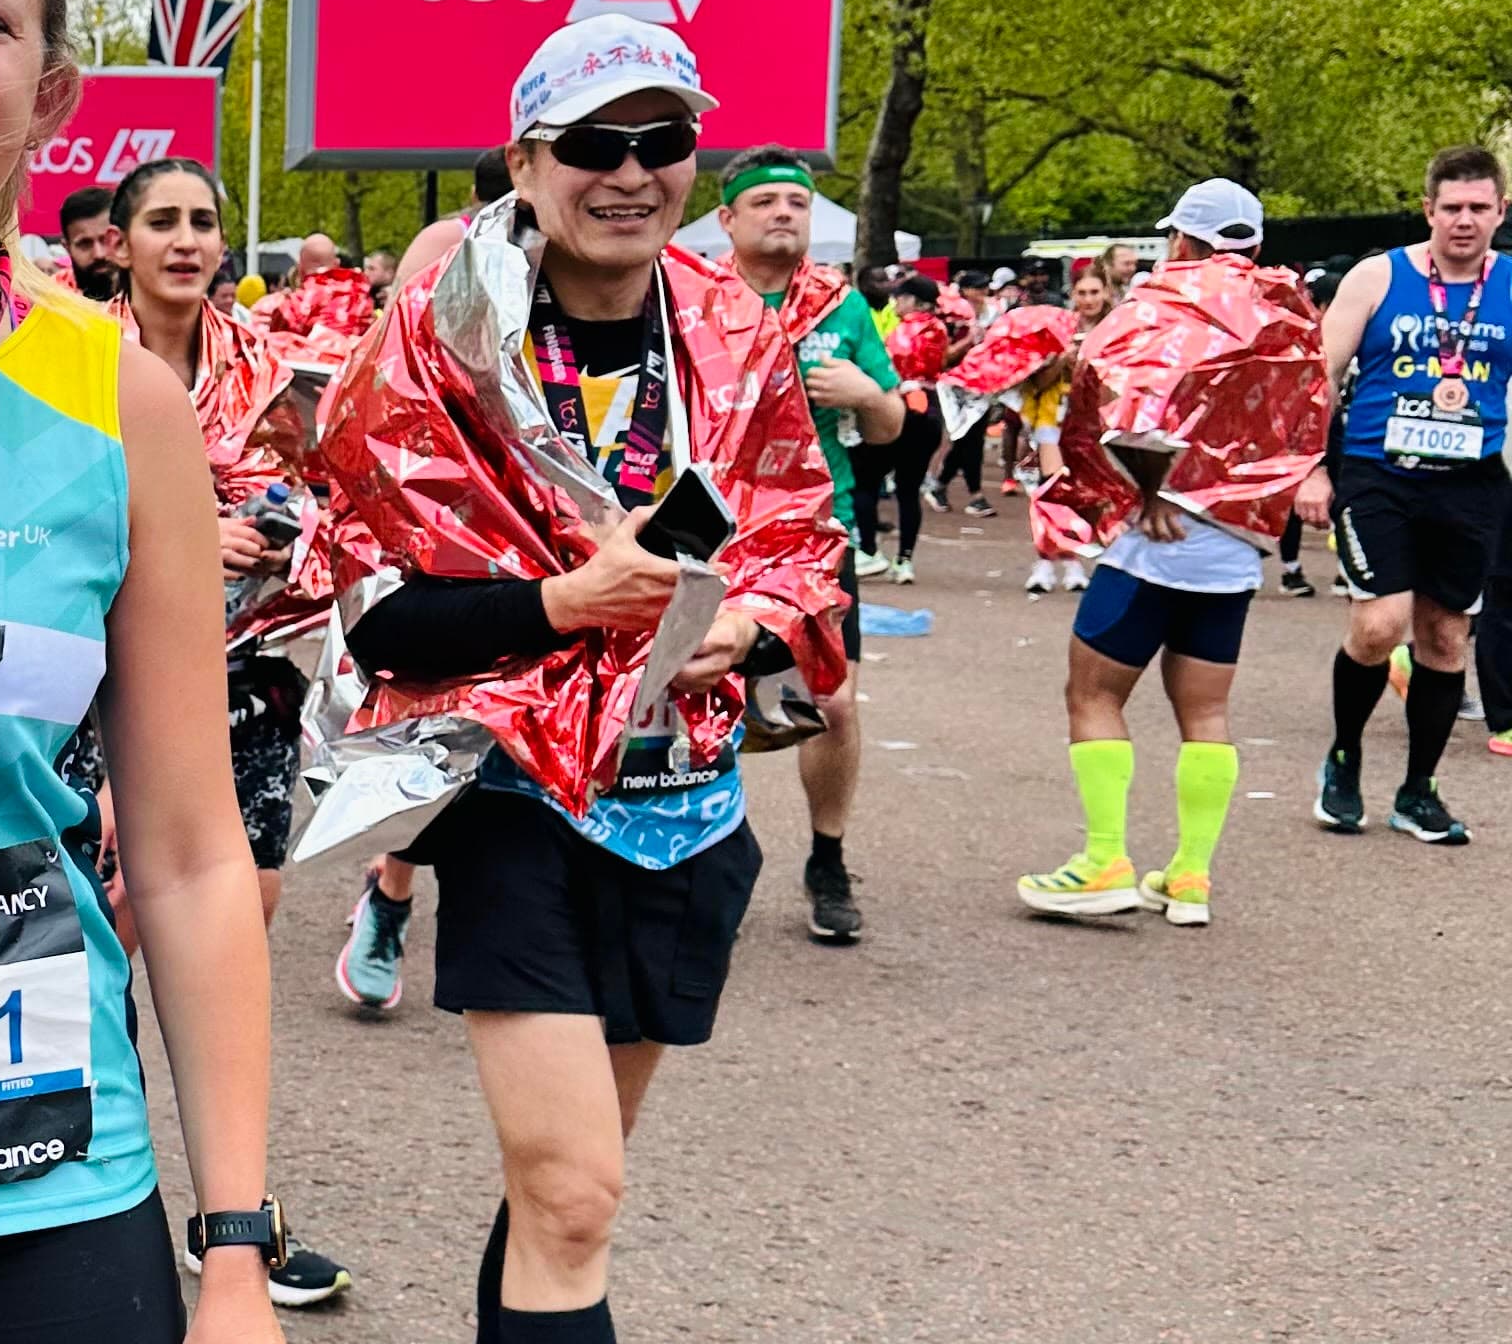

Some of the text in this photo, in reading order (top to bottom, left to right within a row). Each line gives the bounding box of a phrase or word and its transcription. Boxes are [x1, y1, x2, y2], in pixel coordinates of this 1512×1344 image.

[29, 137, 94, 174] cs
[1402, 426, 1467, 453] 71002
[24, 524, 52, 547] UK
[623, 769, 719, 790] new balance
[1, 1078, 34, 1092] FITTED
